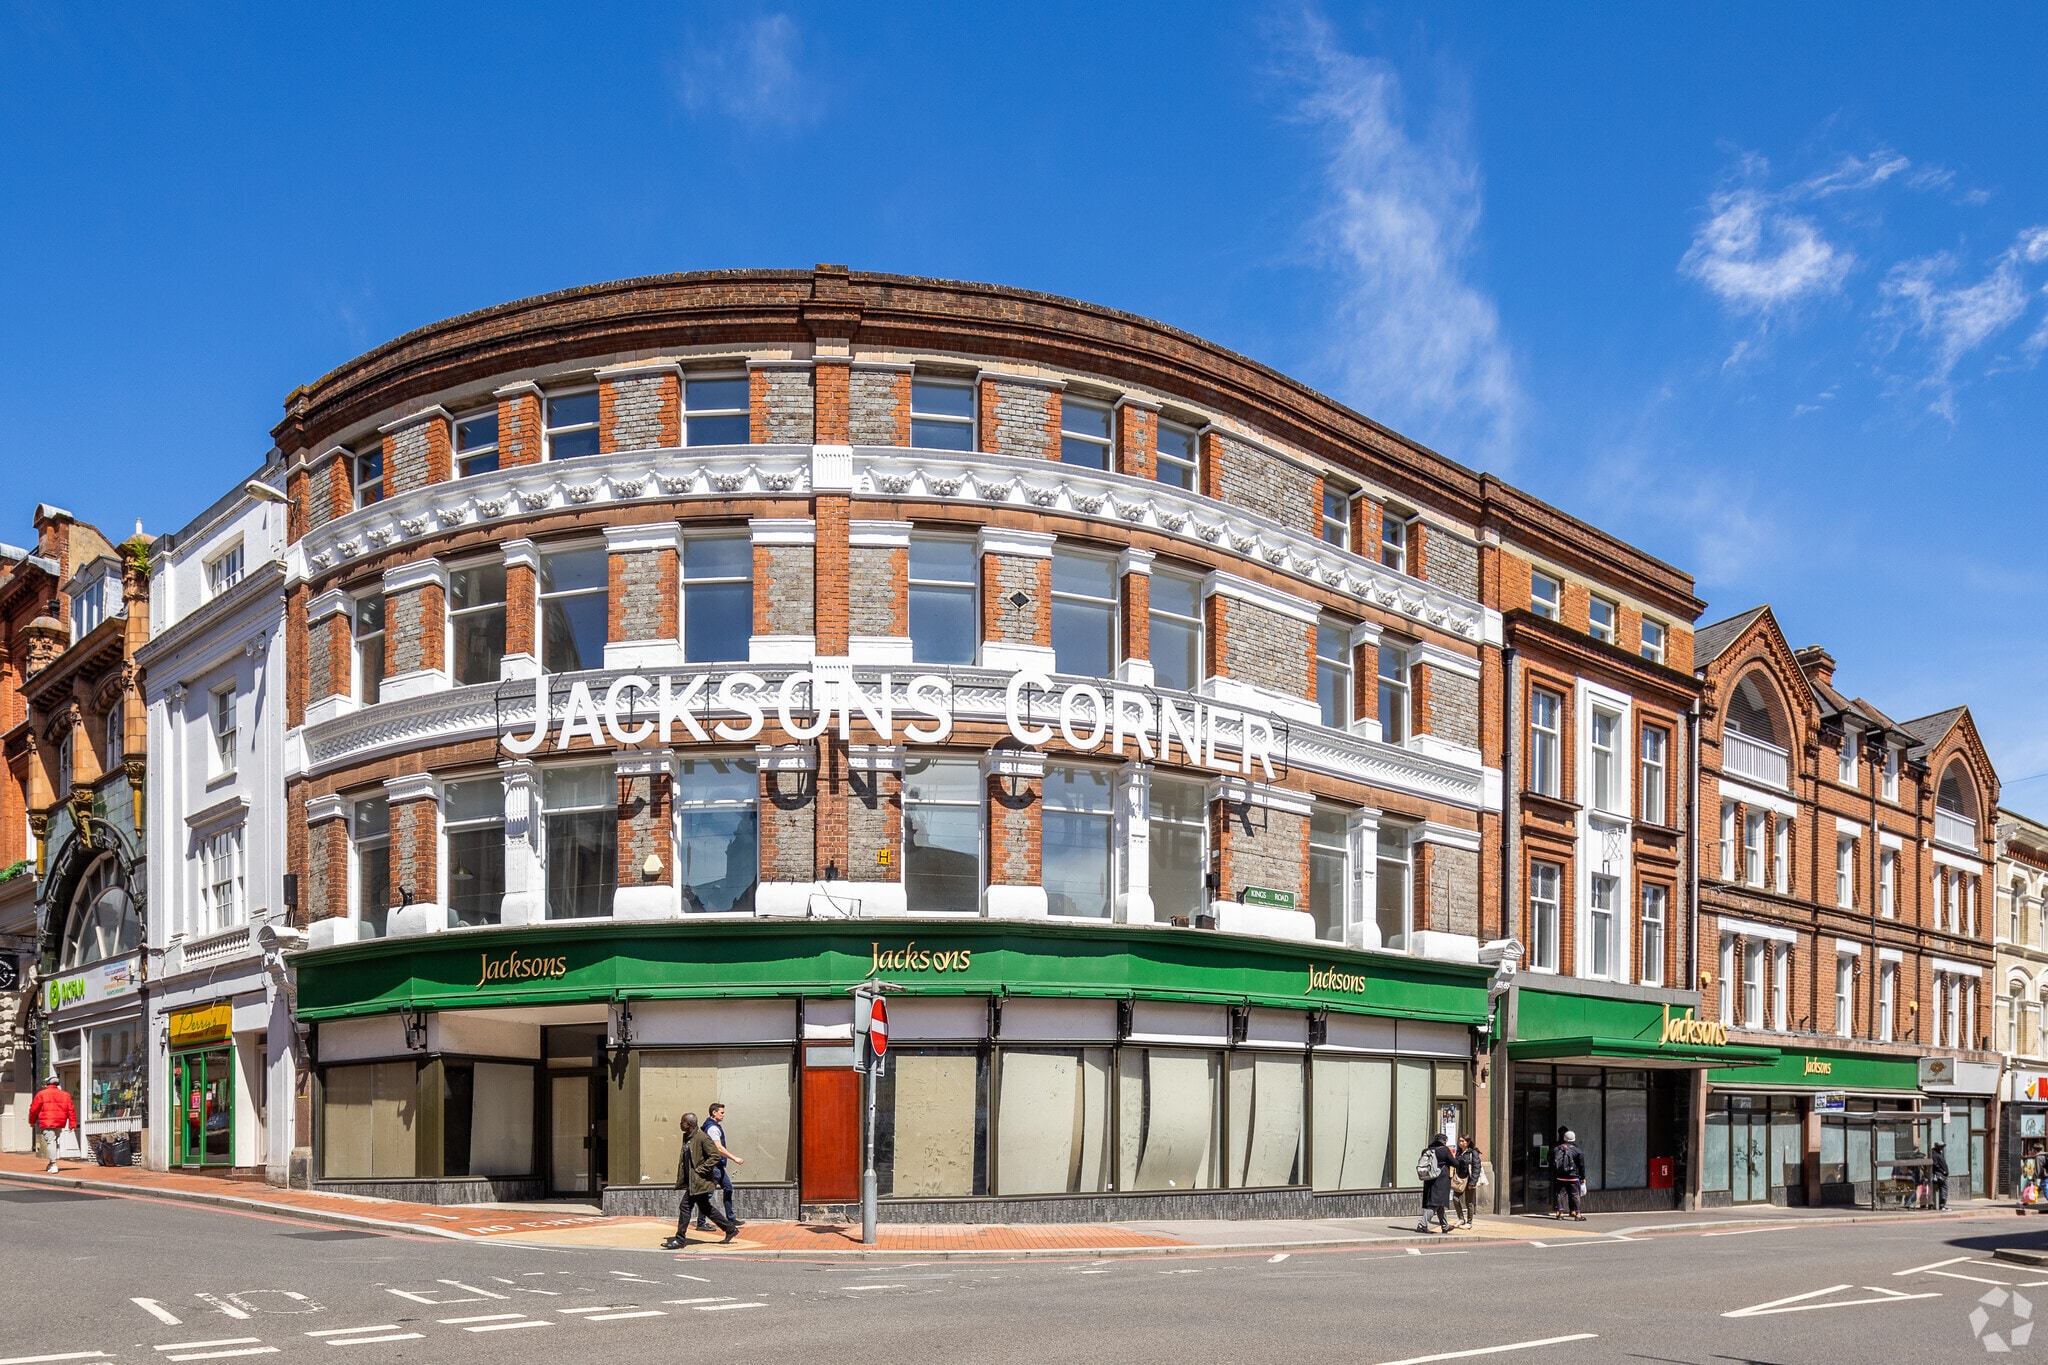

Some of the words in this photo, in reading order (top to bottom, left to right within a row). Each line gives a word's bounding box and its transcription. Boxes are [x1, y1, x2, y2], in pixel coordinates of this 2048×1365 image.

[500, 672, 954, 754] JACKSONS
[1005, 669, 1277, 780] CORNER
[879, 850, 889, 863] H
[1251, 890, 1267, 899] KINGS
[1275, 893, 1289, 902] ROAD
[475, 950, 567, 988] Jacksons
[865, 941, 972, 978] Jacksons
[61, 978, 85, 1001] OXFAM
[1305, 963, 1366, 996] Jacksons
[1659, 1003, 1729, 1047] Jacksons
[1803, 1056, 1832, 1076] Jacksons
